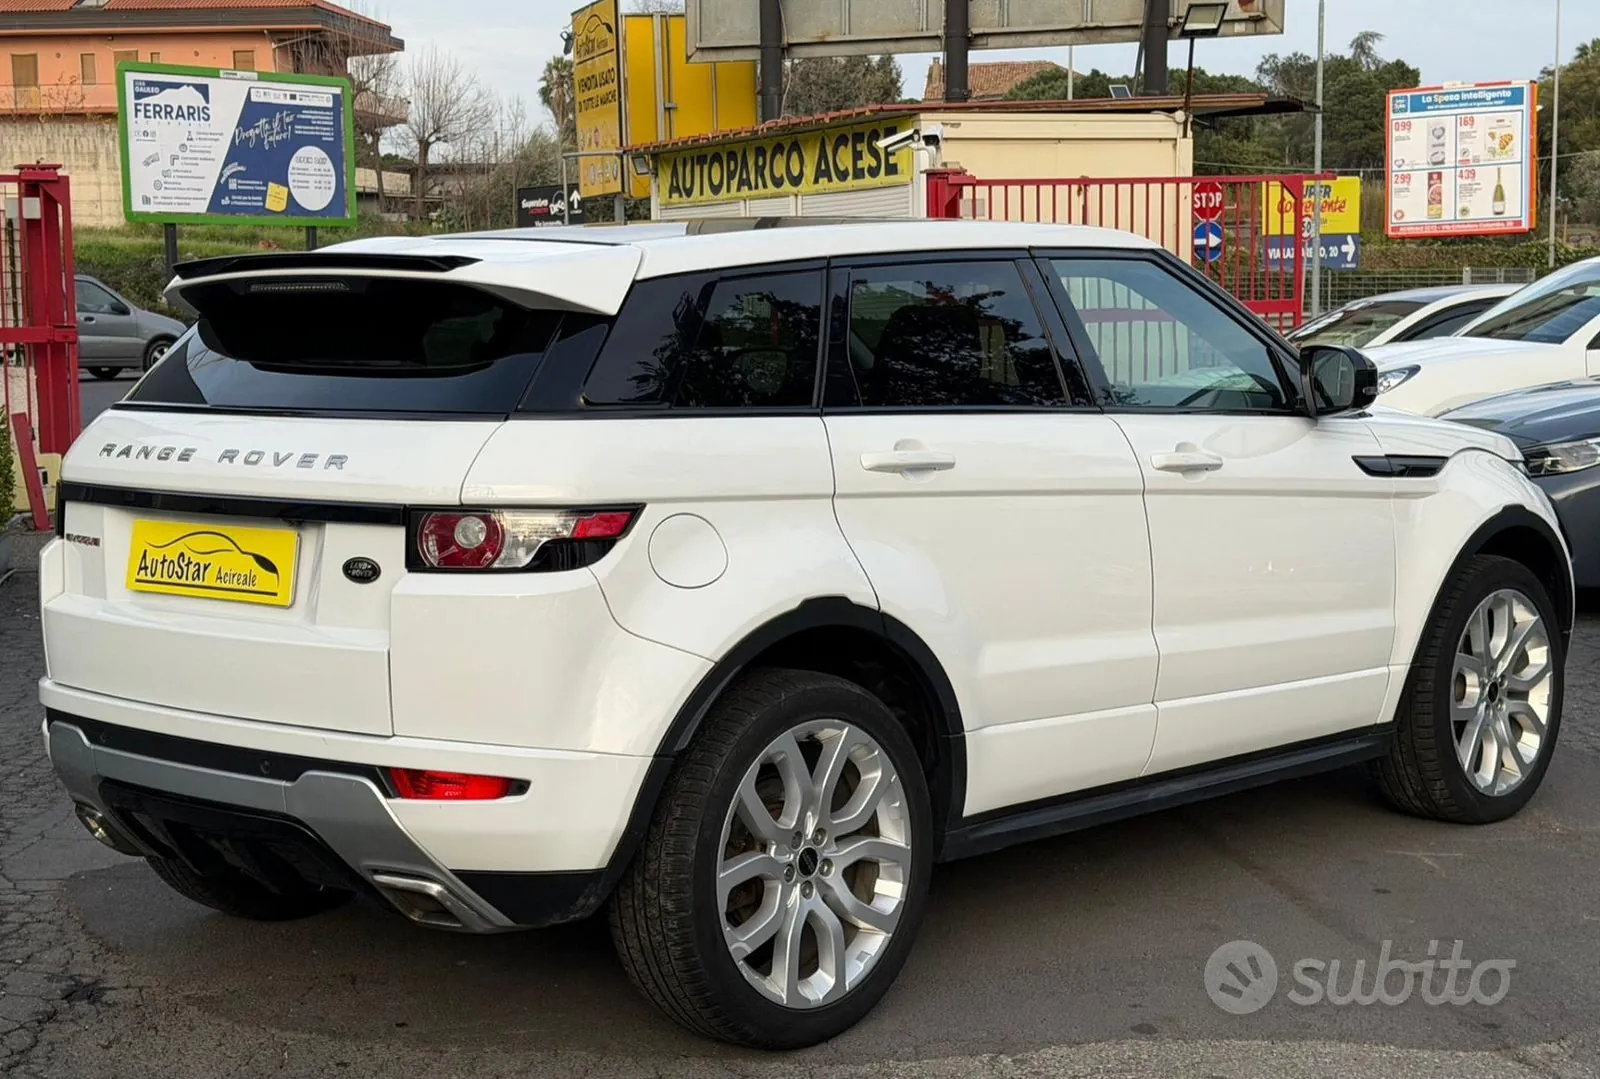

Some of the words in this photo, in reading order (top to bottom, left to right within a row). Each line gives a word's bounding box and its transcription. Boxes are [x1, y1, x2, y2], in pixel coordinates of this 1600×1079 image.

[599, 67, 616, 88] USATO
[1421, 95, 1432, 103] La
[1433, 93, 1460, 104] Spesa
[1461, 90, 1512, 101] Intelligente
[134, 102, 211, 122] FERRARIS
[668, 140, 804, 199] AUTOPARCO
[813, 126, 899, 185] ACESE
[1194, 192, 1223, 209] STOP
[1303, 185, 1332, 199] UPER
[1267, 248, 1281, 259] VIA
[1328, 245, 1339, 257] 20
[98, 443, 197, 463] RANGE
[217, 448, 349, 471] ROVER
[136, 548, 212, 582] AutoStar
[215, 568, 257, 587] Acireale
